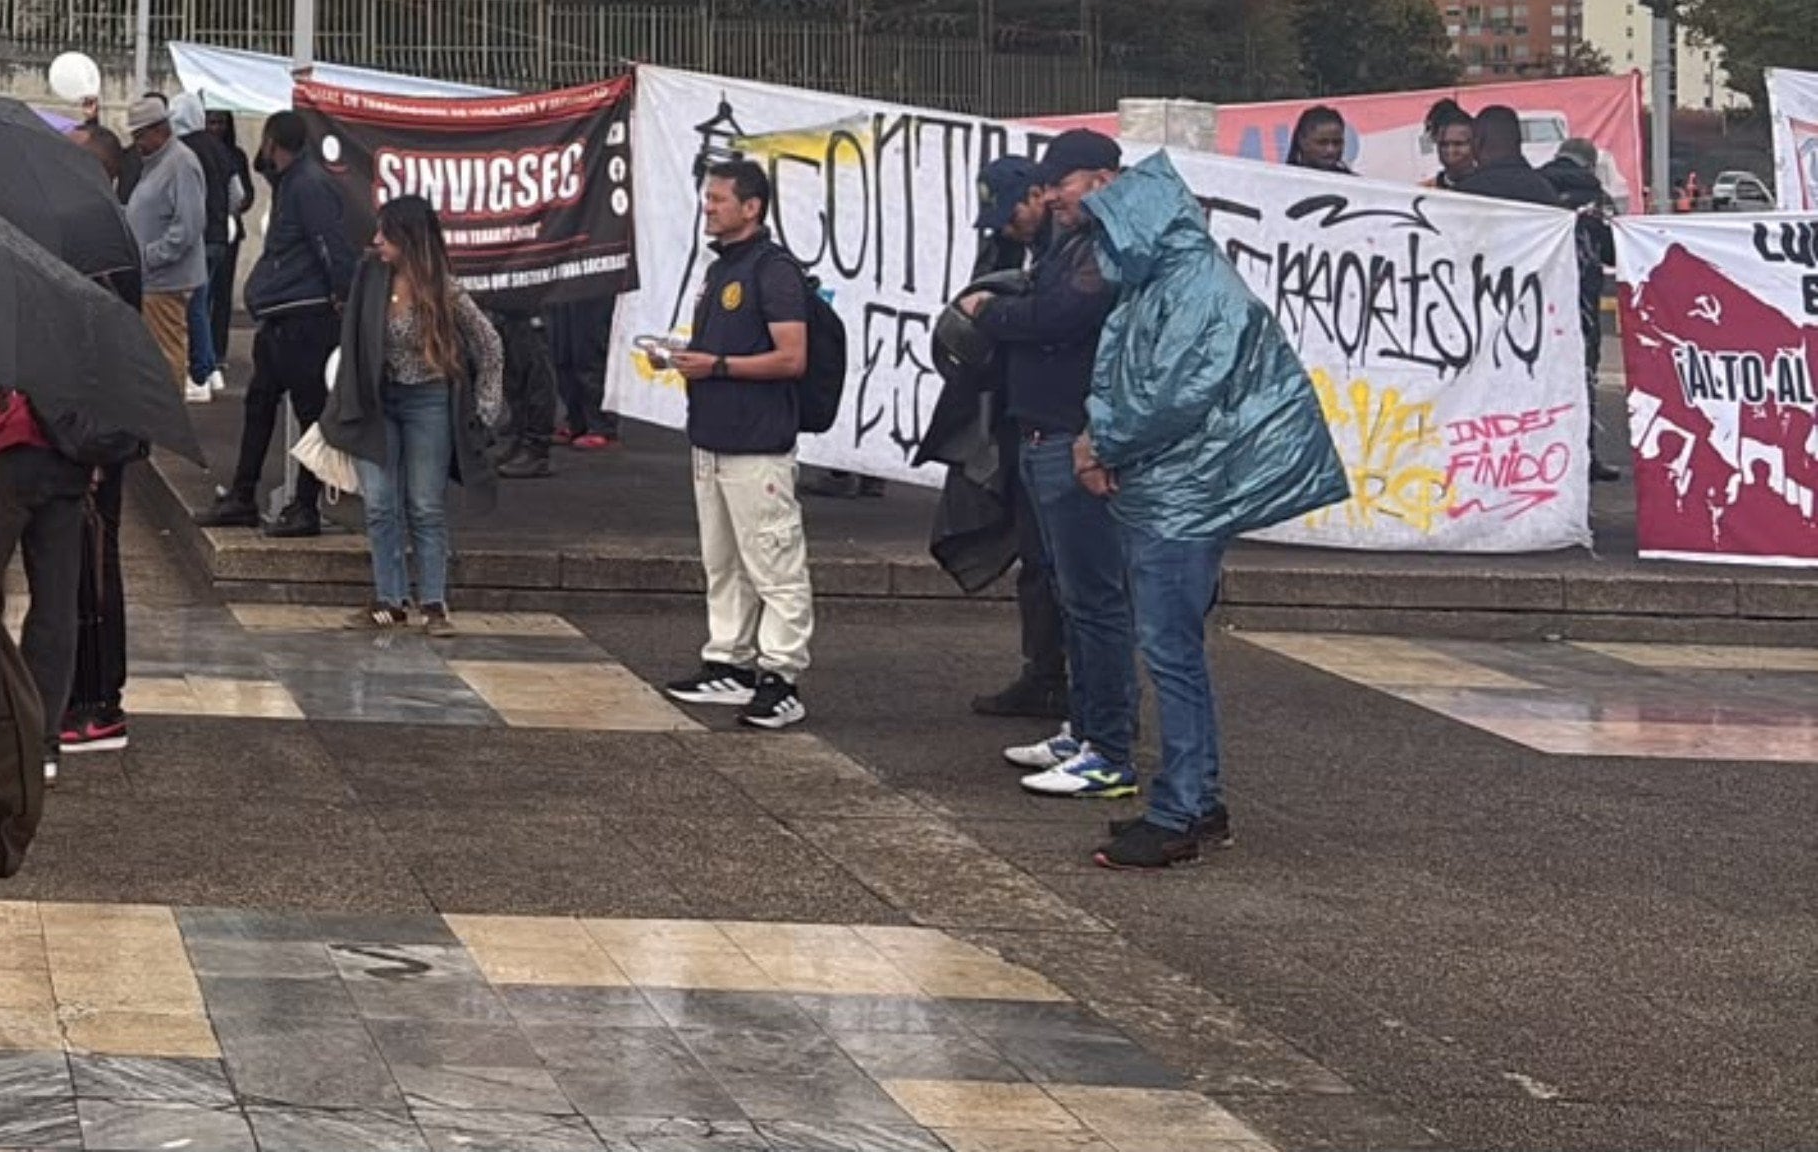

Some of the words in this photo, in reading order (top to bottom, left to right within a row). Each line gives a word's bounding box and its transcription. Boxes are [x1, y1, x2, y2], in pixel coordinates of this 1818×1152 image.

[378, 143, 583, 214] SINVIGSEC
[1195, 195, 1543, 378] RRORISMO
[1778, 356, 1814, 403] AL
[1445, 442, 1569, 494] FINIDO
